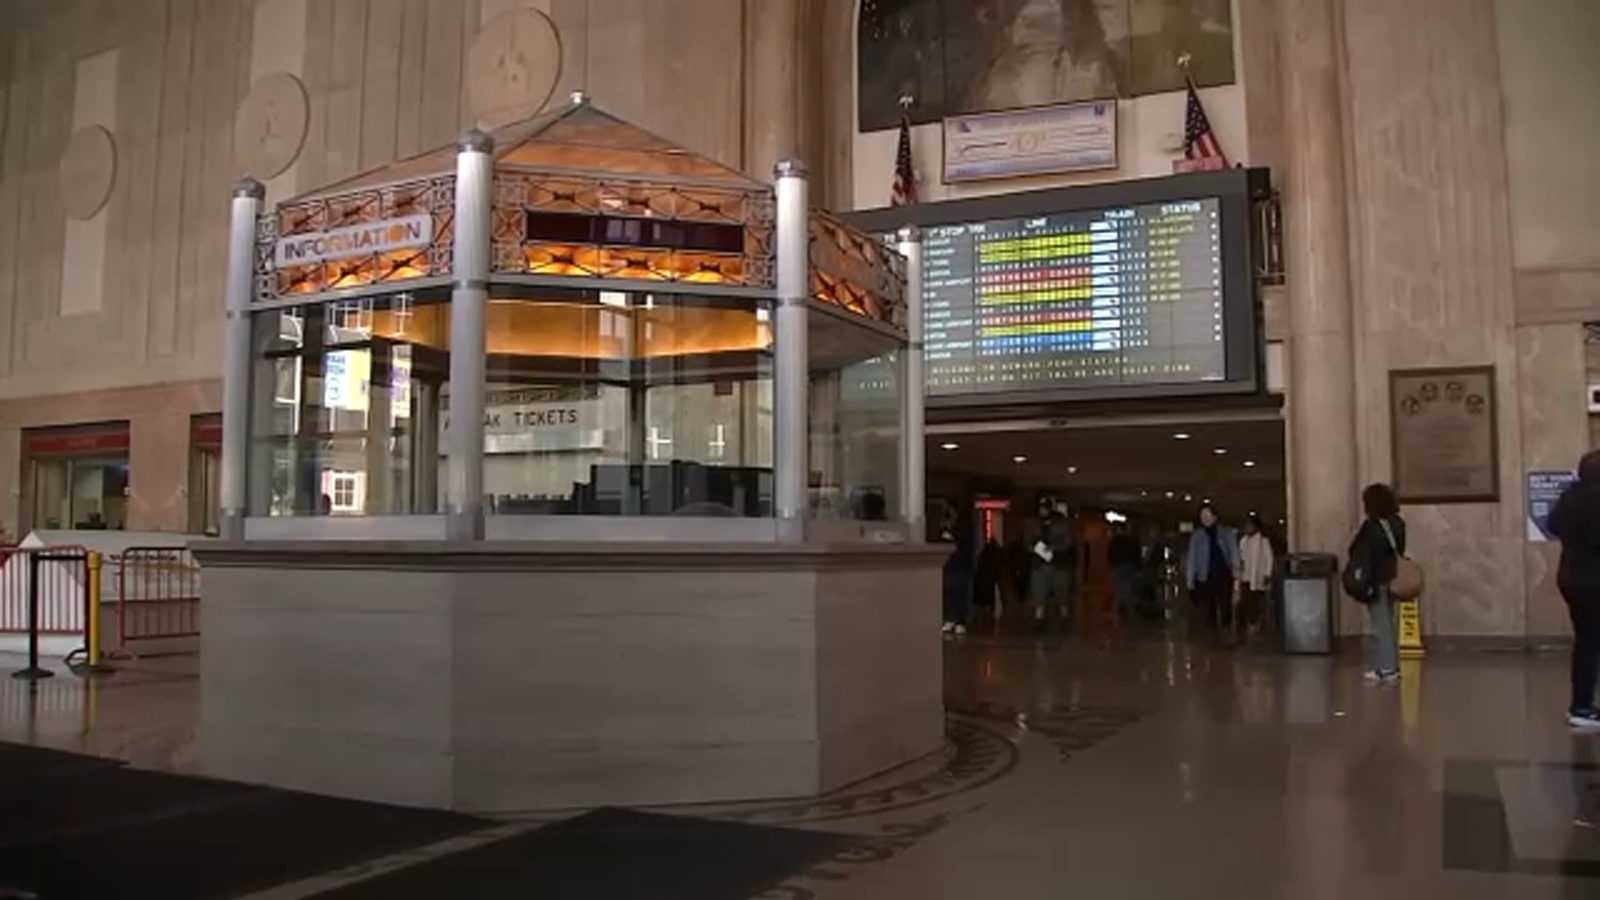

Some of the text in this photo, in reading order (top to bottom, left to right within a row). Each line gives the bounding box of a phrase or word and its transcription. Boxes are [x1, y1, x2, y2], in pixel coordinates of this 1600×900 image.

[1161, 202, 1201, 215] STATUS
[284, 221, 422, 261] INFORMATION
[514, 409, 578, 426] TICKETS
